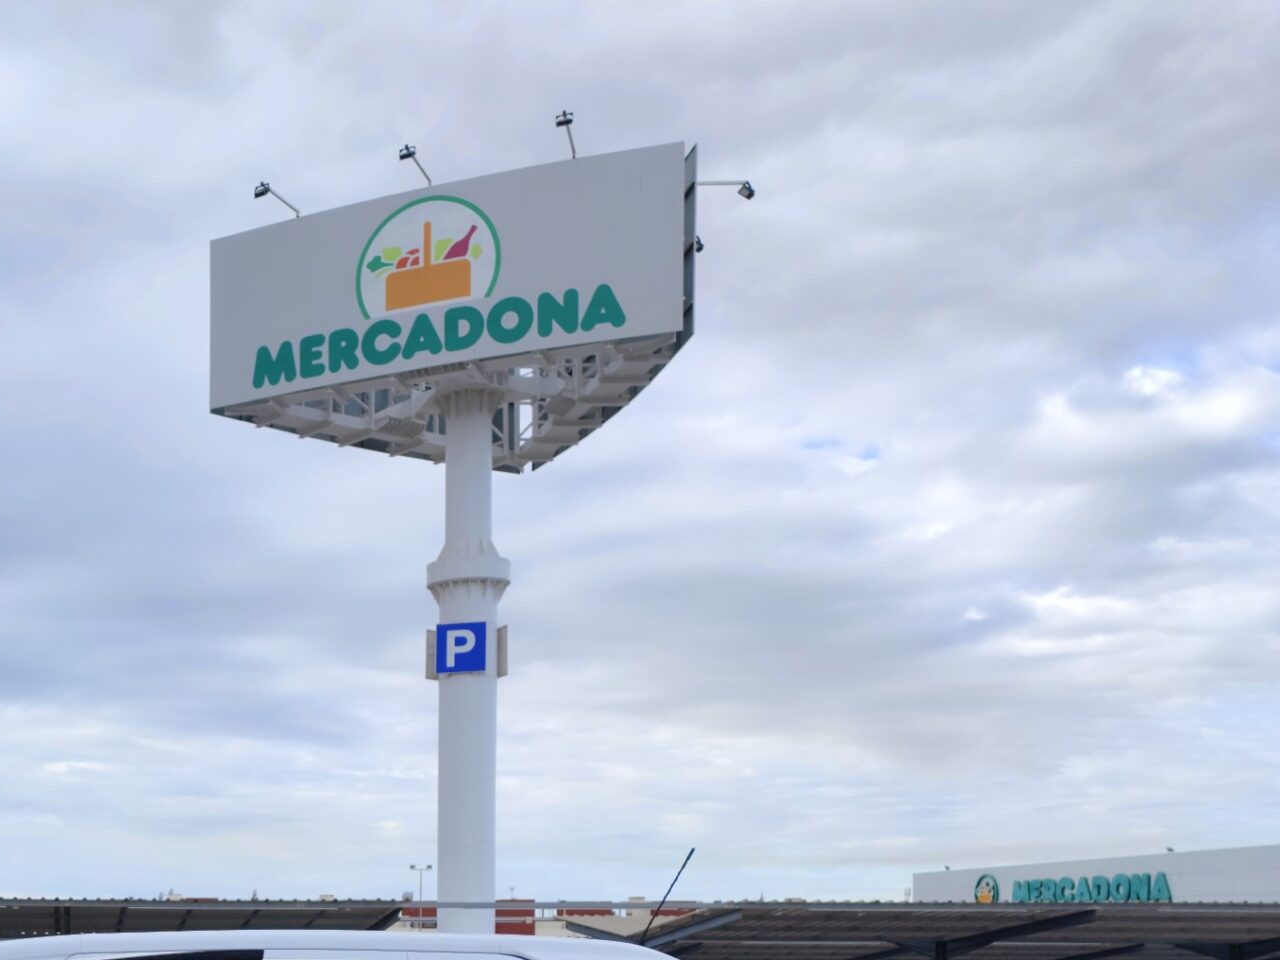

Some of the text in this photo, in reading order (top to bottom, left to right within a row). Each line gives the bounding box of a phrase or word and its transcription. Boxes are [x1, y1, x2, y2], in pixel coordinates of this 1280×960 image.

[252, 283, 626, 389] MERCADONA
[446, 629, 476, 668] P
[1012, 871, 1173, 903] MERCADONA
